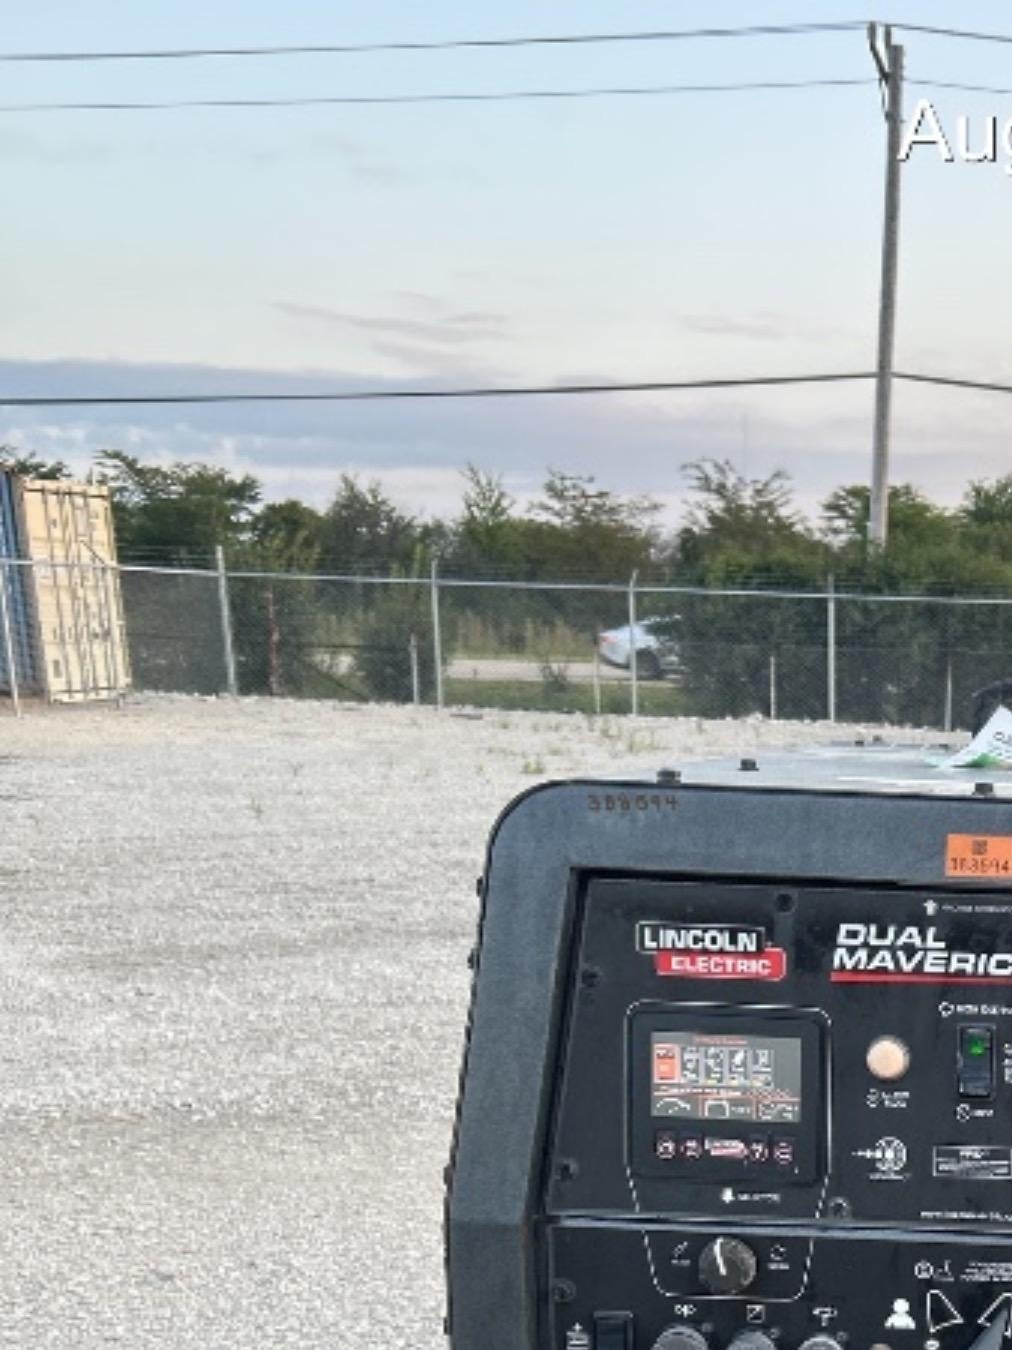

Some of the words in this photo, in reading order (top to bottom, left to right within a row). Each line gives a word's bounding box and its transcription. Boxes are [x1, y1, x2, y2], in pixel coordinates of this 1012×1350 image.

[643, 925, 758, 953] LINCOLN
[836, 922, 947, 949] DUAL
[670, 956, 773, 976] ELECTRIC
